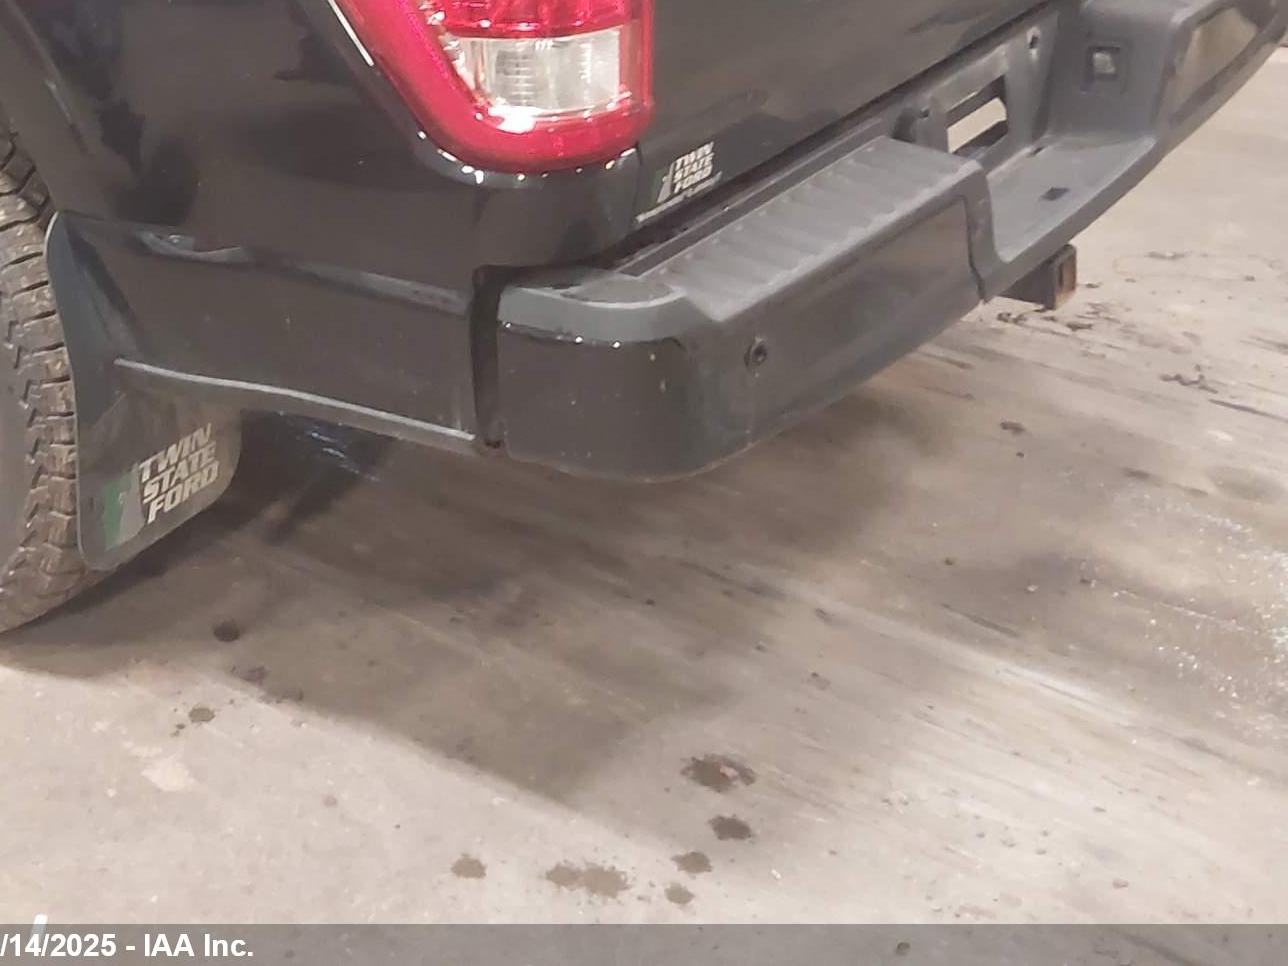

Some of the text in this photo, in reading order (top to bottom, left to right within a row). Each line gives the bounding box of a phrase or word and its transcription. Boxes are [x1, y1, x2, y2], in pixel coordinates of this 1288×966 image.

[138, 422, 212, 484] TWIN
[142, 440, 217, 506] STATE
[146, 459, 220, 526] FORD
